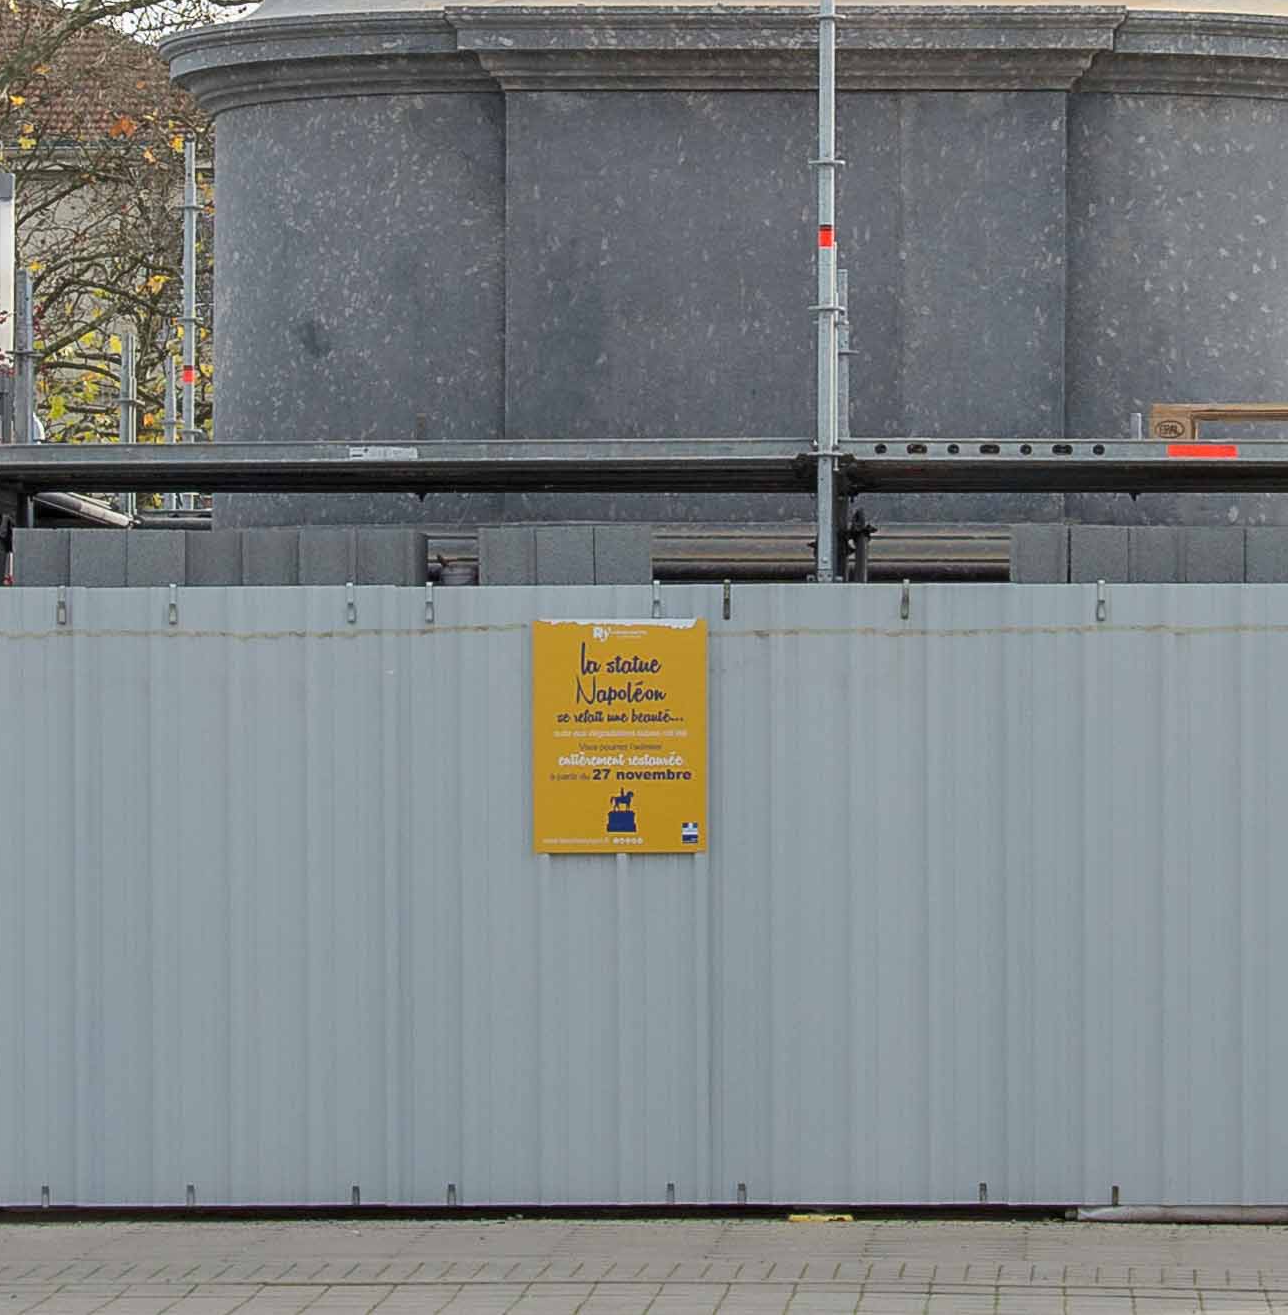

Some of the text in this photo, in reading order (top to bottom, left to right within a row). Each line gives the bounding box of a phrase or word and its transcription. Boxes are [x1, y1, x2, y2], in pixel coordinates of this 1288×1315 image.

[606, 655, 661, 674] statue
[576, 676, 666, 705] Napoléon
[557, 713, 570, 723] se
[574, 710, 603, 723] refait
[607, 713, 628, 722] une
[558, 751, 682, 766] entièrement restaurée
[593, 769, 611, 780] 27
[616, 769, 692, 781] novembre
